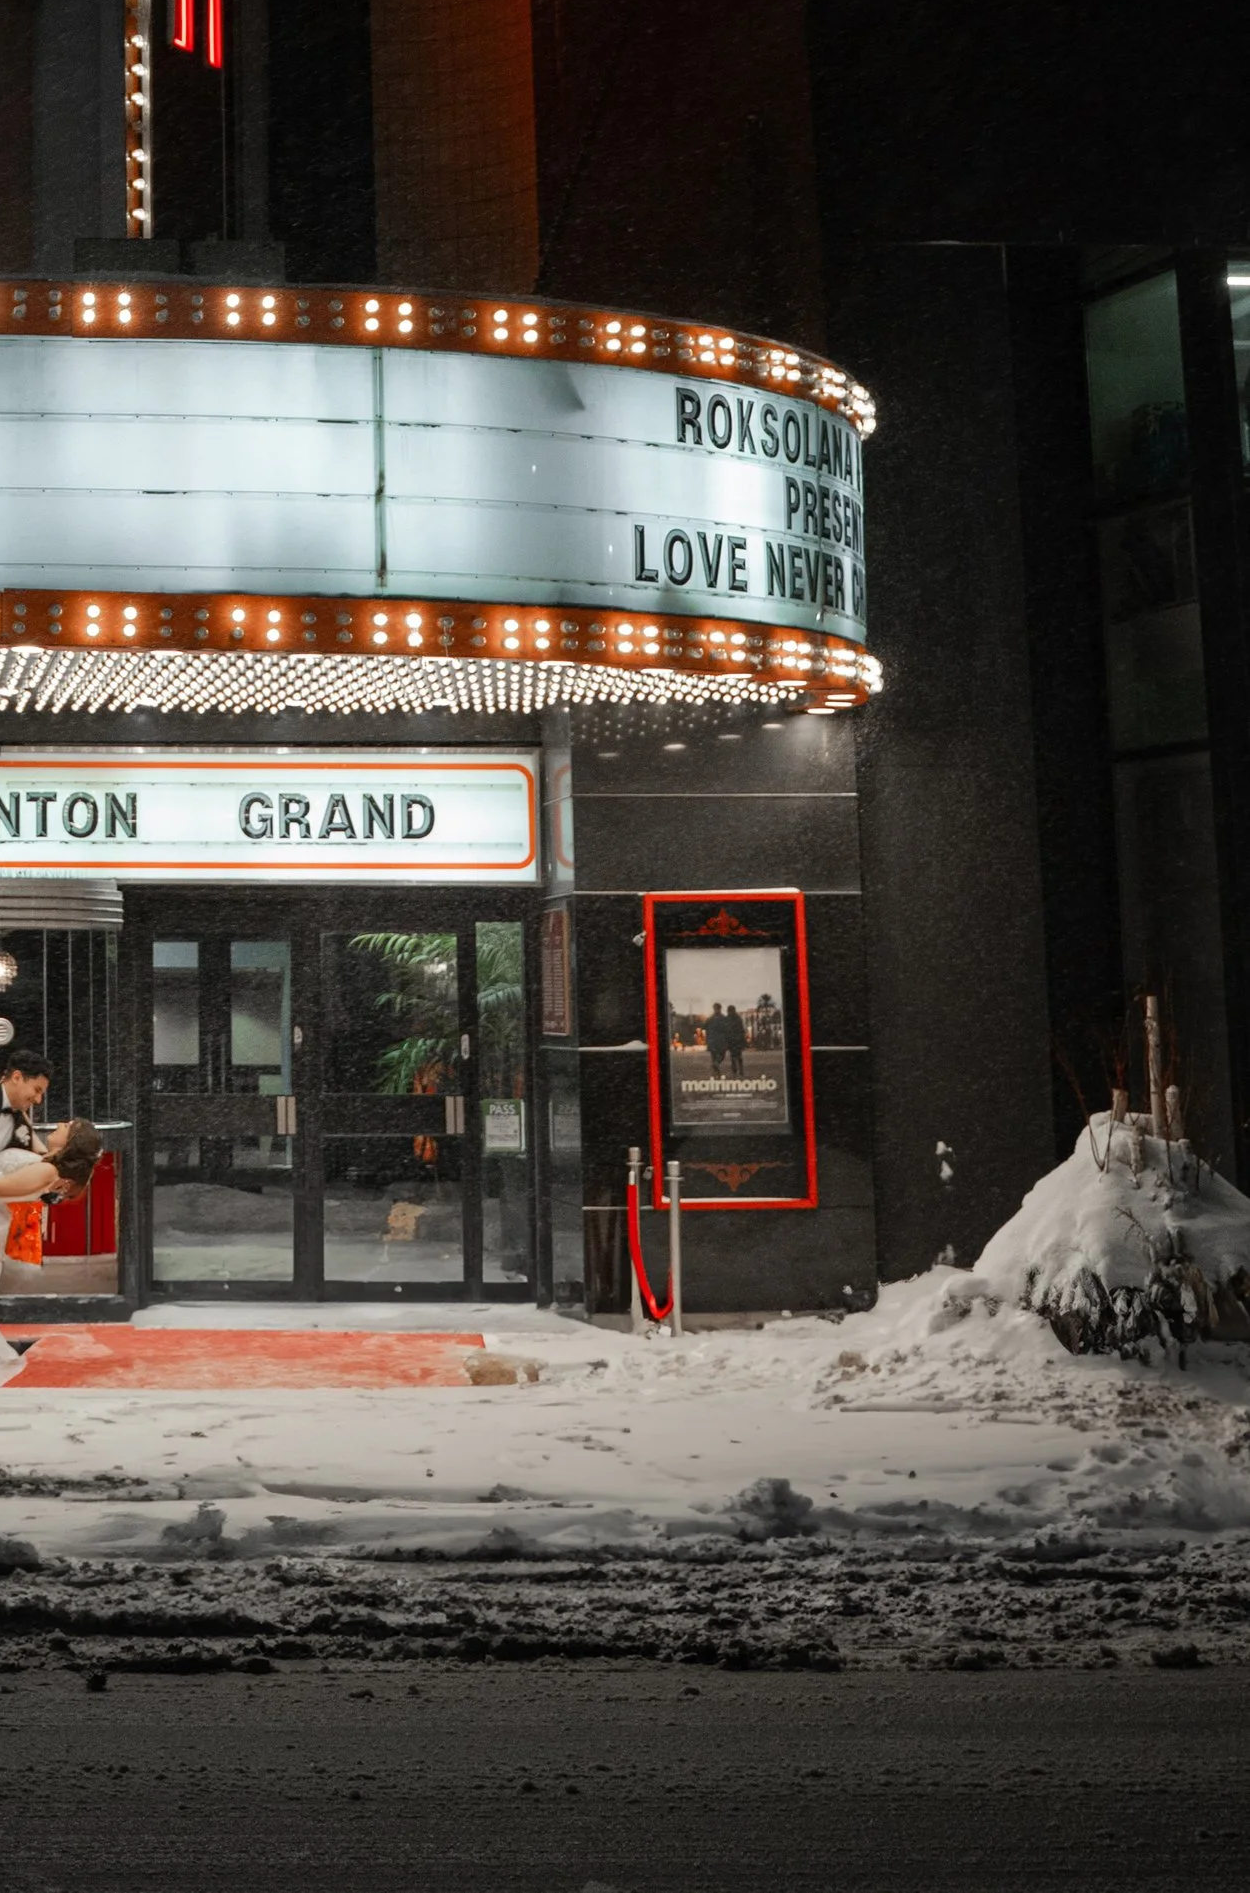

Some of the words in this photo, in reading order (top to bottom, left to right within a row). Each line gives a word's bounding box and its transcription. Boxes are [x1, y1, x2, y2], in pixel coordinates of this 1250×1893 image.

[675, 387, 854, 486] ROKSOLANA
[785, 476, 863, 557] PRESENT
[634, 524, 748, 592] LOVE
[766, 541, 846, 612] NEVER
[238, 791, 436, 840] GRAND
[489, 1104, 517, 1115] PASS
[681, 1074, 778, 1092] matrimonio
